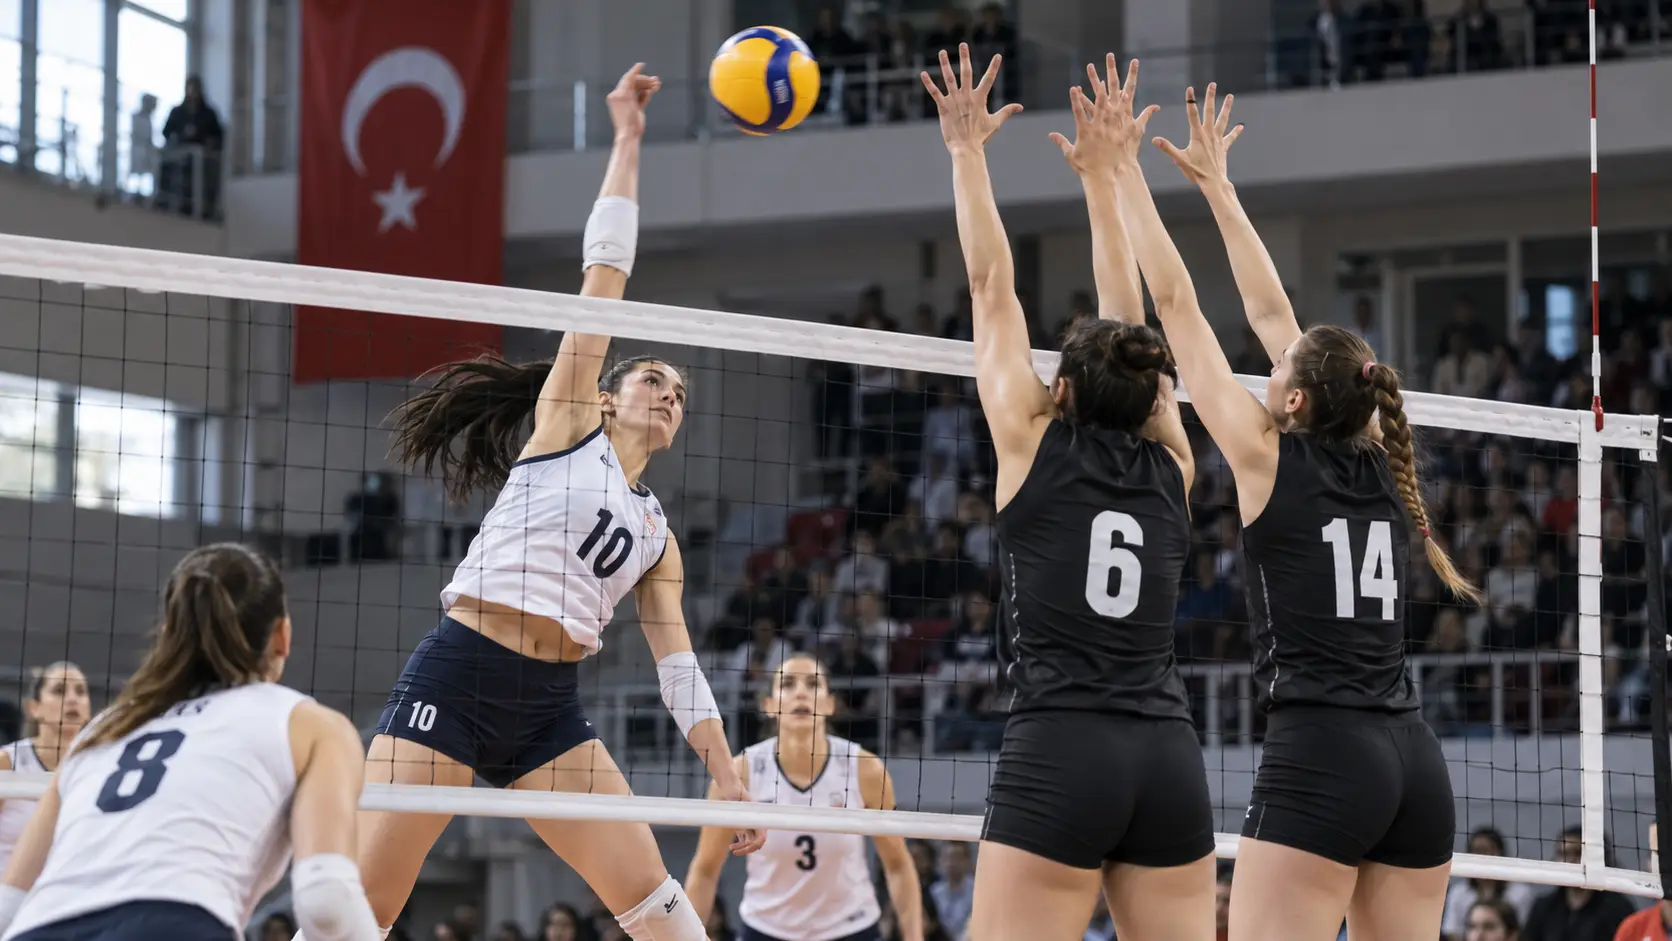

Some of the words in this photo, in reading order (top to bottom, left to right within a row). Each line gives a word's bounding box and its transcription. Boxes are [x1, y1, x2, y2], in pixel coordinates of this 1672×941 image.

[576, 508, 633, 578] 10
[1085, 510, 1144, 618] 6
[1321, 518, 1398, 620] 14
[408, 701, 437, 731] 10
[95, 729, 186, 814] 8
[794, 835, 817, 871] 3
